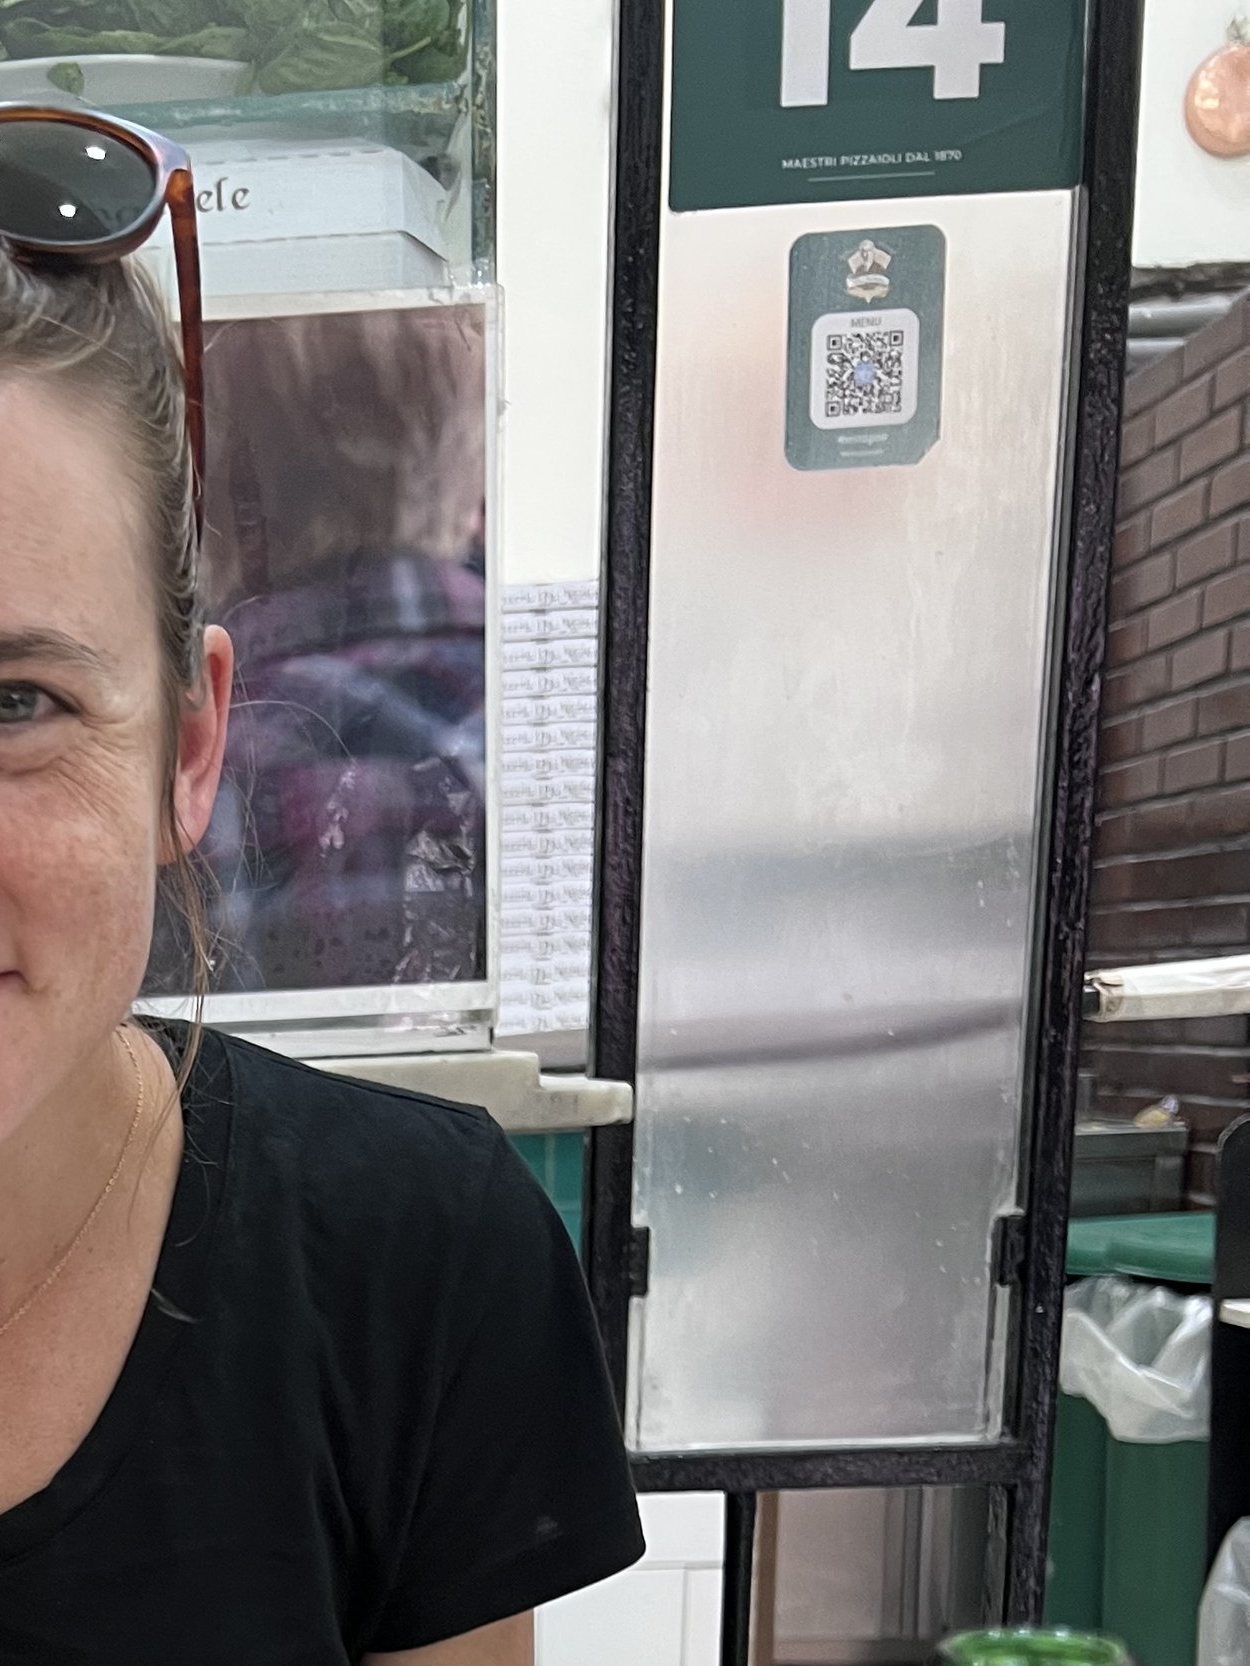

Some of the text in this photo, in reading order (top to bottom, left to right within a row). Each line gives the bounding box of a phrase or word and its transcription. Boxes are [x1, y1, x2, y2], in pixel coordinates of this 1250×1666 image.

[780, 0, 1005, 107] 14
[782, 157, 837, 170] MAESTRI
[840, 153, 902, 167] PIZZAIOLI
[905, 151, 930, 163] DAL
[851, 316, 882, 328] MENU
